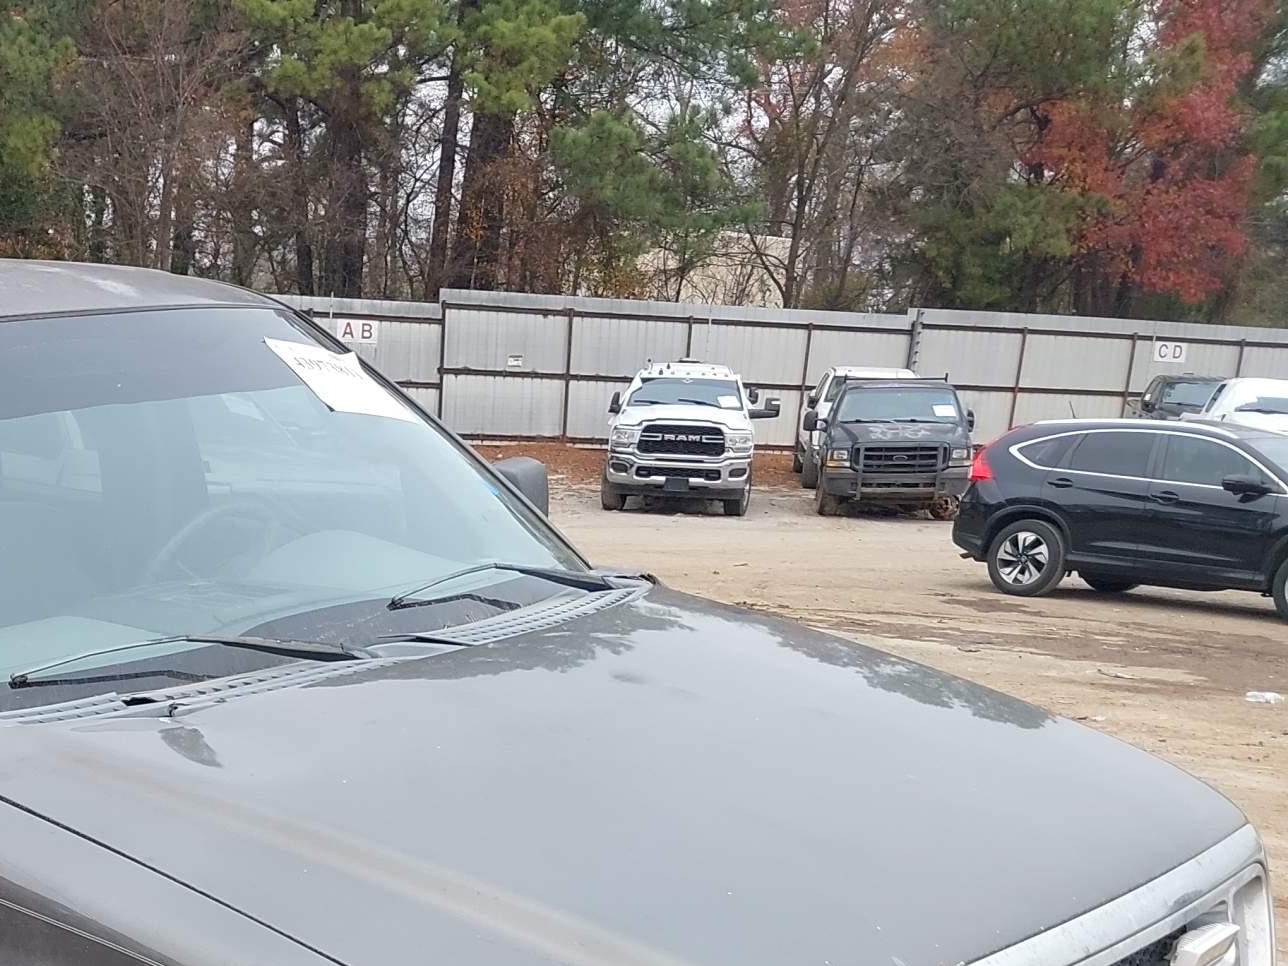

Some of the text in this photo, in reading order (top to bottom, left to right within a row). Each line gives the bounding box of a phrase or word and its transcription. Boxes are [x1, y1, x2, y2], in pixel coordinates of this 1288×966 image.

[342, 322, 373, 340] A B
[1158, 343, 1183, 359] C D
[663, 434, 701, 442] RAM
